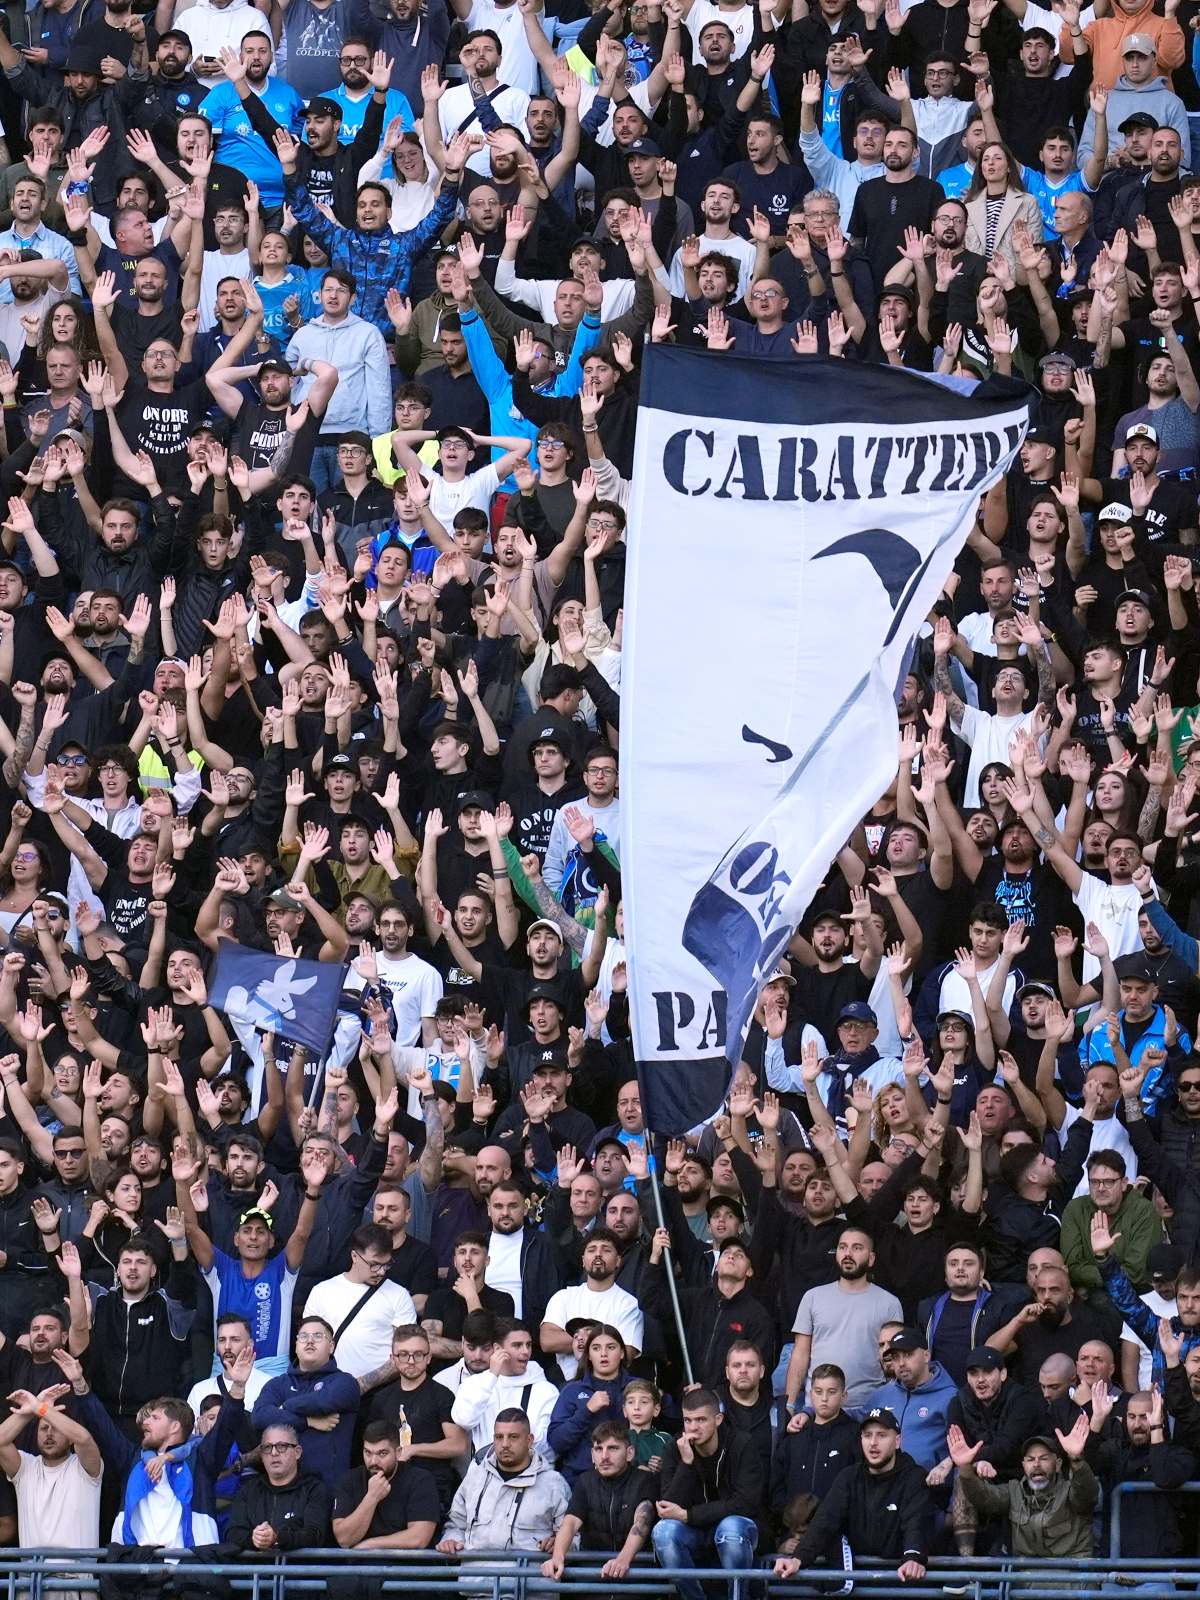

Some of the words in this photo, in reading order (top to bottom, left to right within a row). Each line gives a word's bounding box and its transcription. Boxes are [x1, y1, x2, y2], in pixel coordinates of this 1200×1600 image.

[296, 49, 340, 57] COLDPLA
[143, 405, 189, 424] ONORE
[520, 808, 553, 831] ONO
[652, 990, 728, 1051] PA
